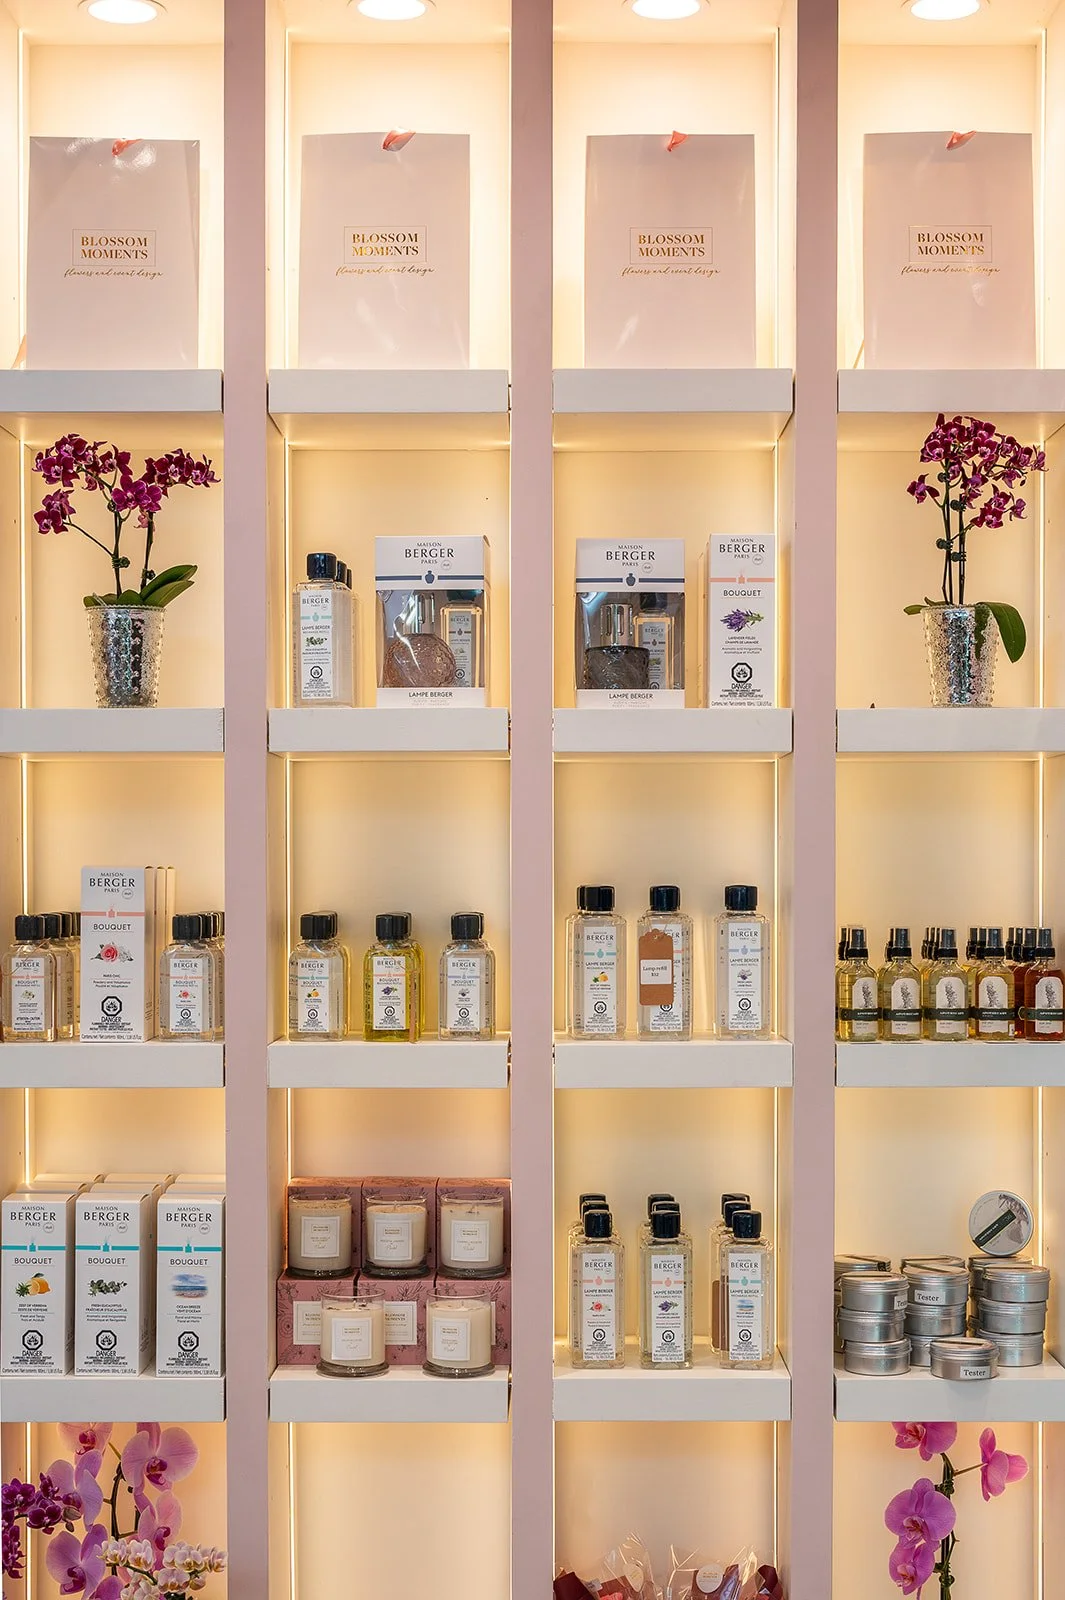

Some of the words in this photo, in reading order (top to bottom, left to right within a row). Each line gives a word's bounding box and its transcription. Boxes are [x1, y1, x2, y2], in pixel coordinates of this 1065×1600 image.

[81, 236, 148, 247] BLOSSOM
[352, 233, 418, 243] BLOSSOM
[638, 234, 704, 244] BLOSSOM
[918, 232, 984, 242] BLOSSOM
[81, 249, 148, 259] MOMENTS
[352, 246, 419, 256] MOMENTS
[638, 246, 705, 257] MOMENTS
[918, 245, 984, 255] MOMENTS
[404, 548, 454, 558] BERGER
[720, 544, 766, 553] BERGER
[606, 550, 656, 560] BERGER
[723, 590, 762, 598] BOUQUET
[89, 878, 135, 887] BERGER
[10, 1212, 56, 1221] BERGER
[84, 1212, 129, 1221] BERGER
[166, 1213, 212, 1222] BERGER
[917, 1293, 939, 1301] Tester
